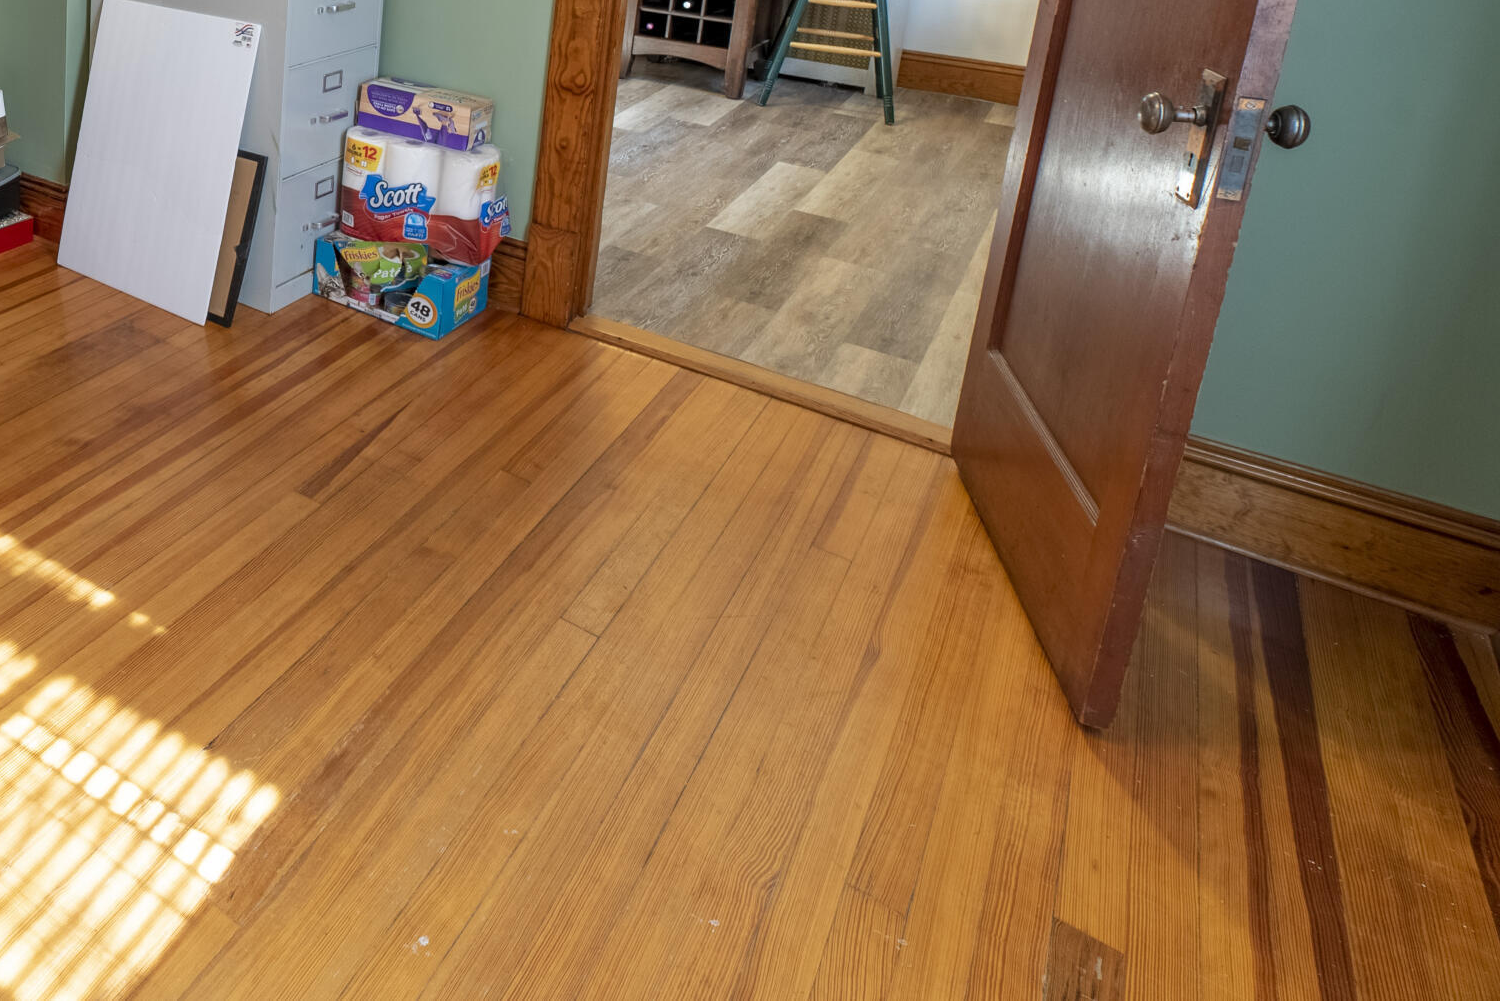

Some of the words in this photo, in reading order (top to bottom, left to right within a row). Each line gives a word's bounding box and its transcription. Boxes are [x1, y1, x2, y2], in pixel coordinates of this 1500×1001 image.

[363, 146, 377, 160] 12
[369, 180, 422, 208] Scott
[343, 249, 379, 261] Friskies
[410, 310, 426, 323] CANS
[411, 301, 431, 318] 48
